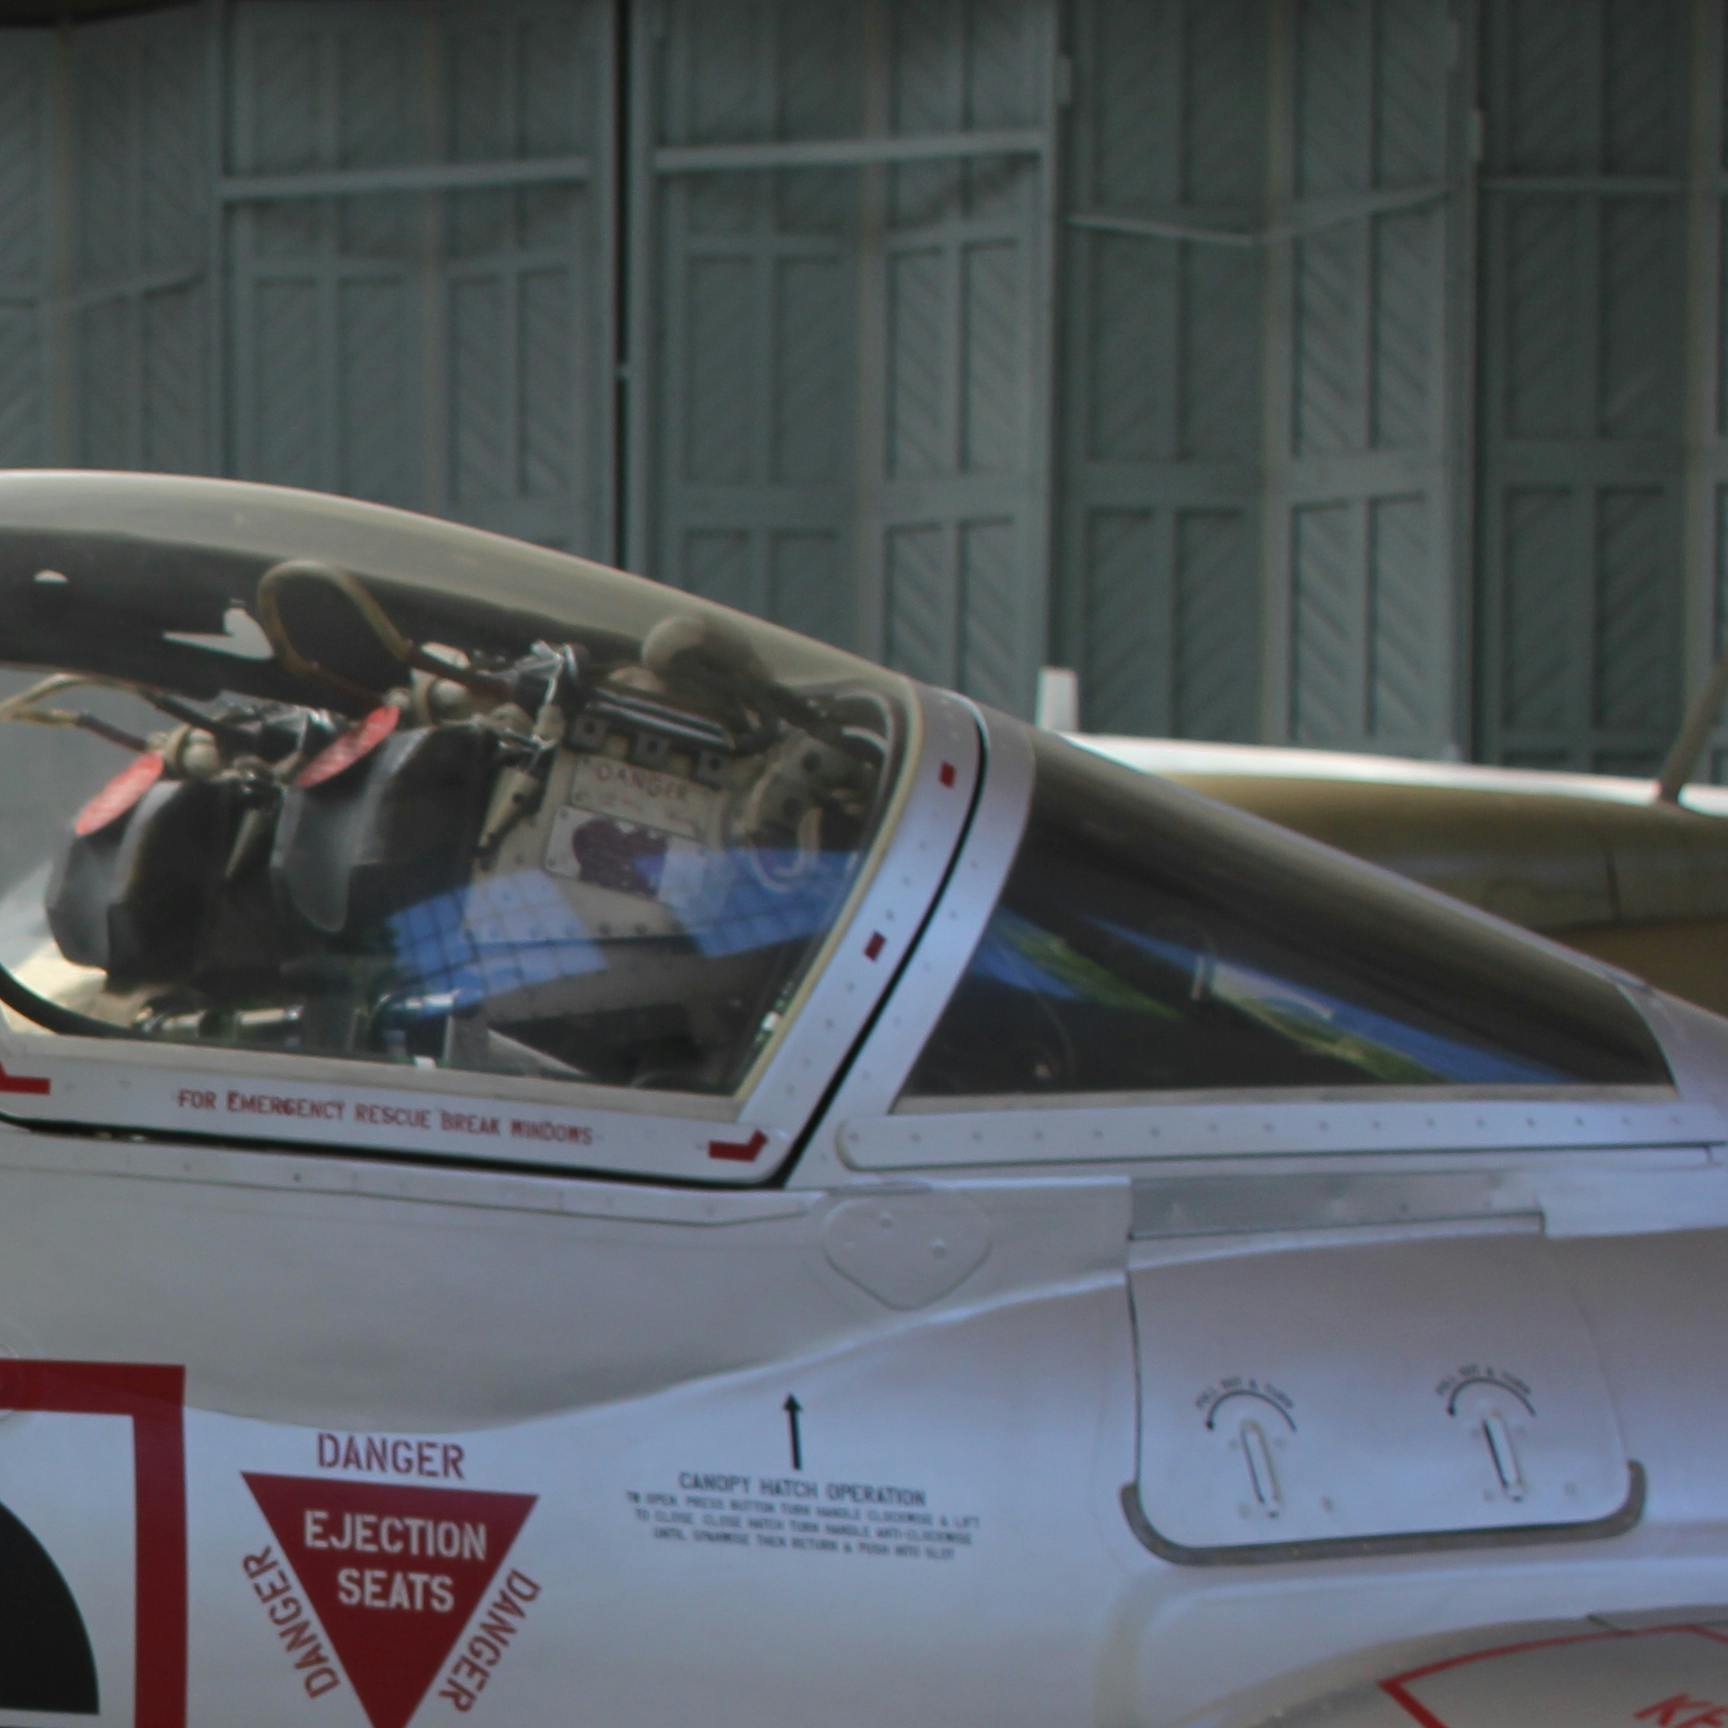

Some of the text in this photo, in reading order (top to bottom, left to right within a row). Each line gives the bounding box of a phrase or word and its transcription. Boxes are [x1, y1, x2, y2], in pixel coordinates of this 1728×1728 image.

[178, 1089, 593, 1146] FOR EMERGENCY RESCUE BREAK WINDOWS
[317, 1432, 465, 1480] DANGER
[678, 1472, 926, 1506] CANOPY HATCH OPERATION
[304, 1510, 487, 1562] EJECTION
[337, 1568, 455, 1613] SEATS
[242, 1546, 341, 1700] DANGER
[438, 1568, 541, 1713] DANGER
